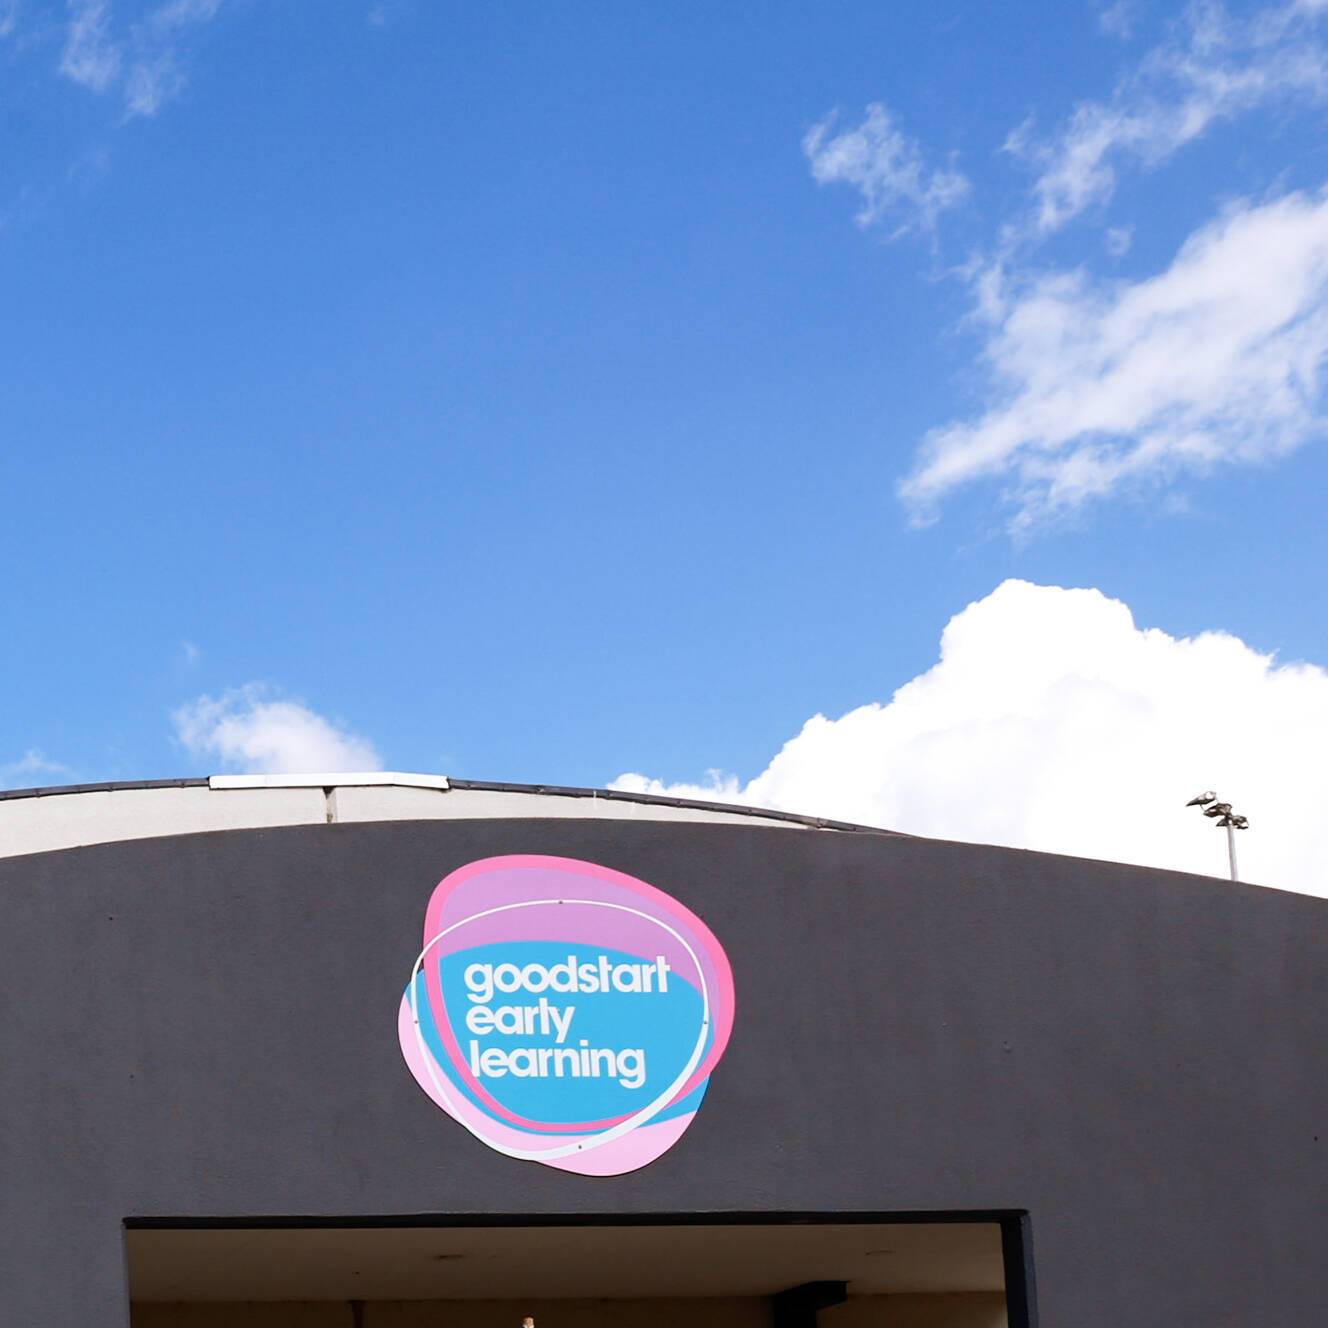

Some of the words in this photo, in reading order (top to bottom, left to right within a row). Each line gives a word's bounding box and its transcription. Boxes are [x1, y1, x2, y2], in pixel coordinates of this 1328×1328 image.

[463, 955, 671, 1004] goodstart
[465, 997, 576, 1043] early
[469, 1039, 646, 1089] learning
